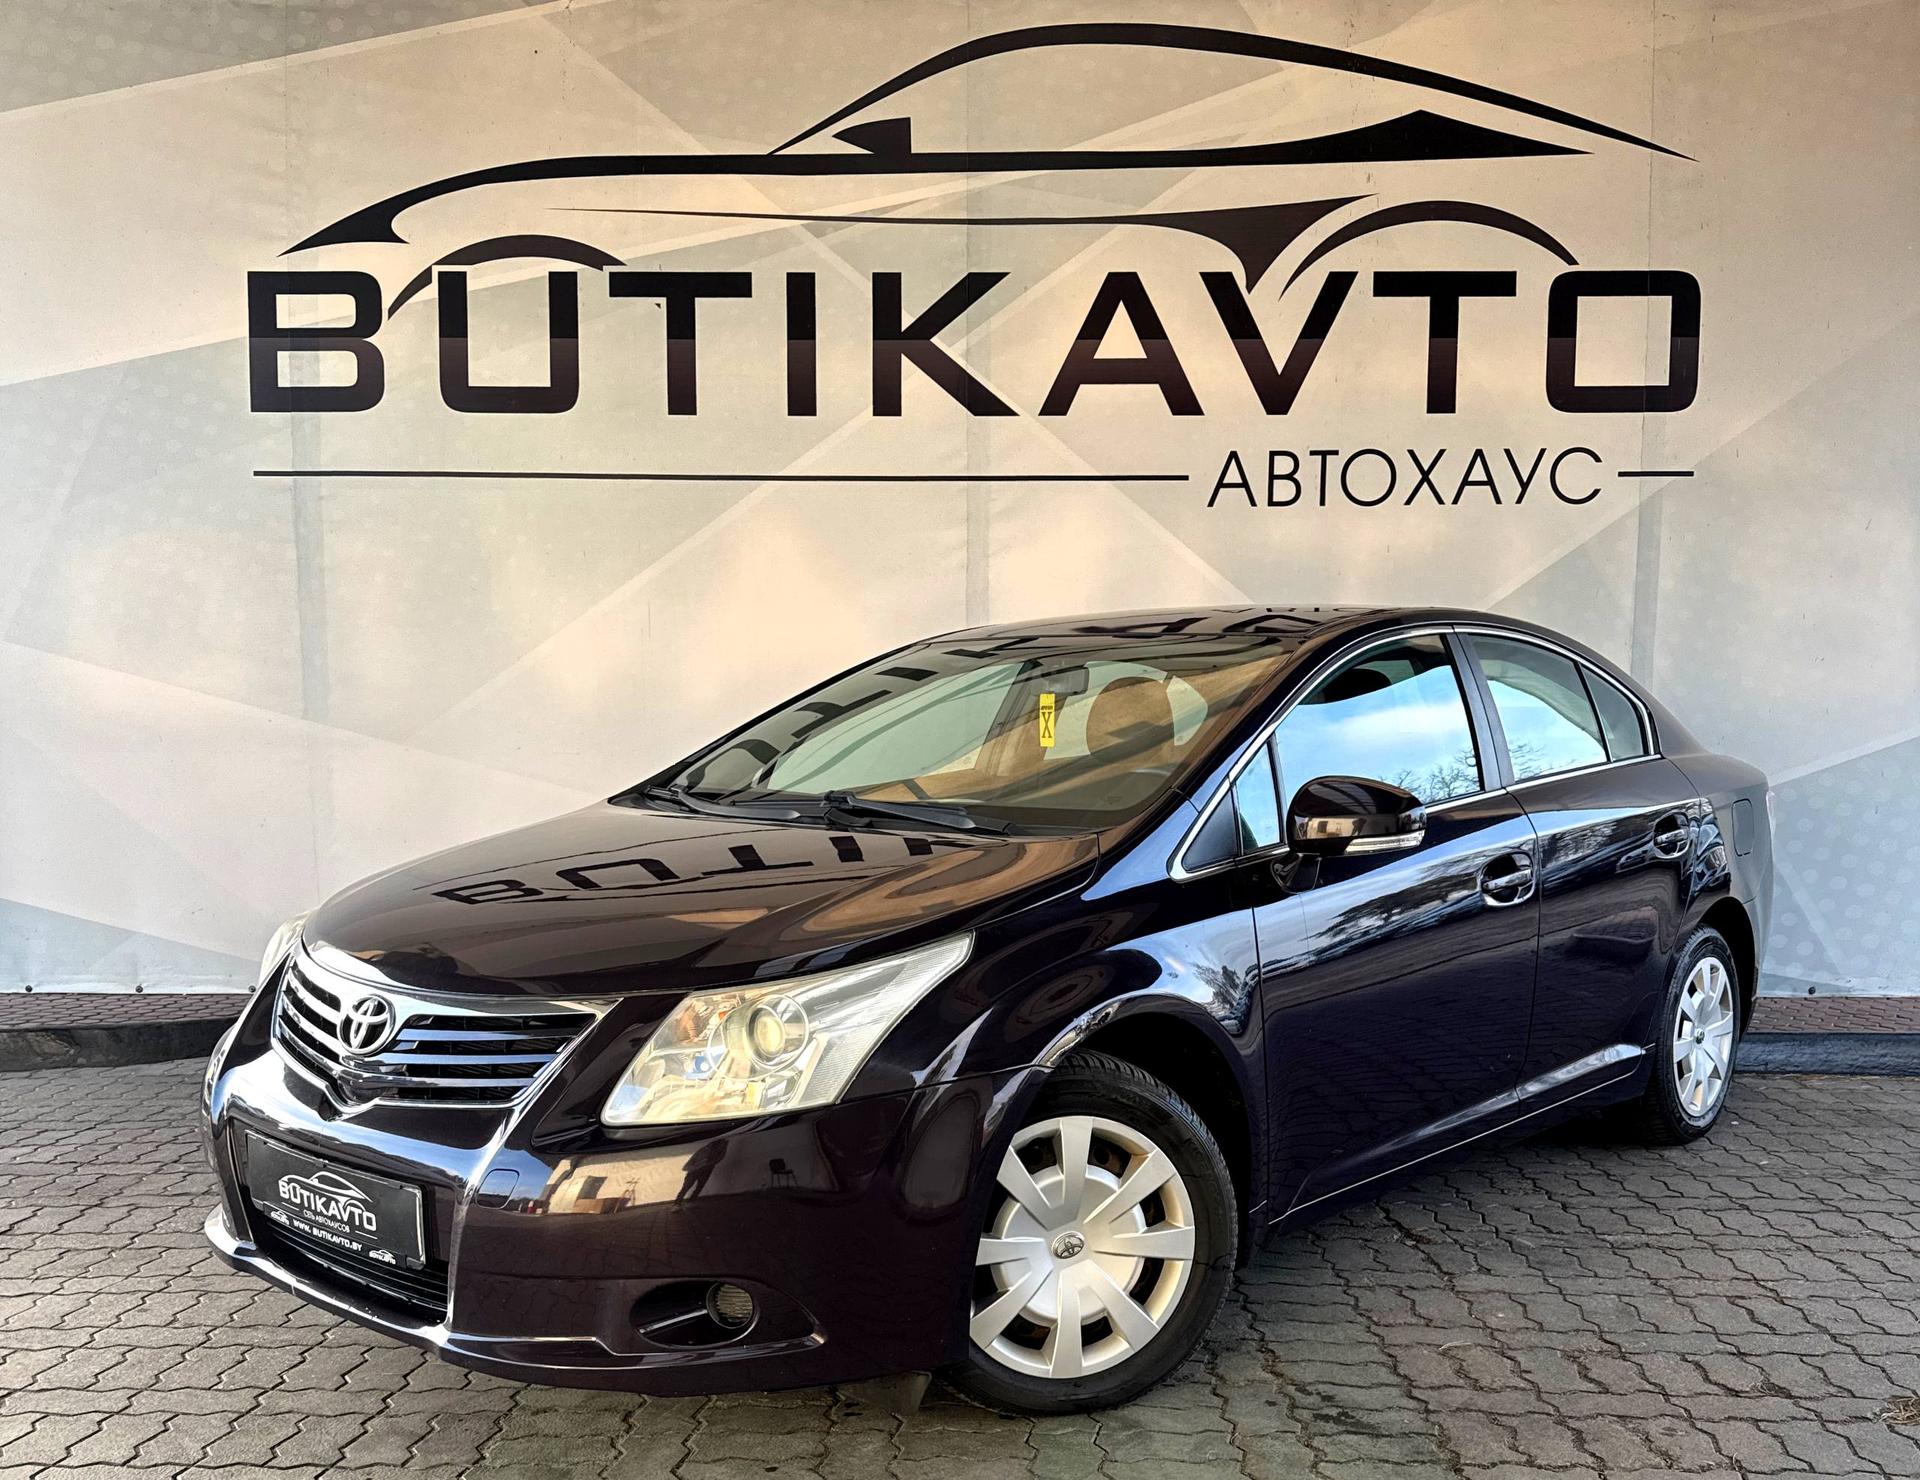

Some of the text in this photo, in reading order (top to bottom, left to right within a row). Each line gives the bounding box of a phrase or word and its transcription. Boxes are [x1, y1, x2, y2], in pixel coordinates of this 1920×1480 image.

[247, 270, 1702, 417] BUTIKAVTO
[1207, 446, 1602, 508] АВТОХАУС
[278, 1179, 377, 1232] BUTIKAVTO
